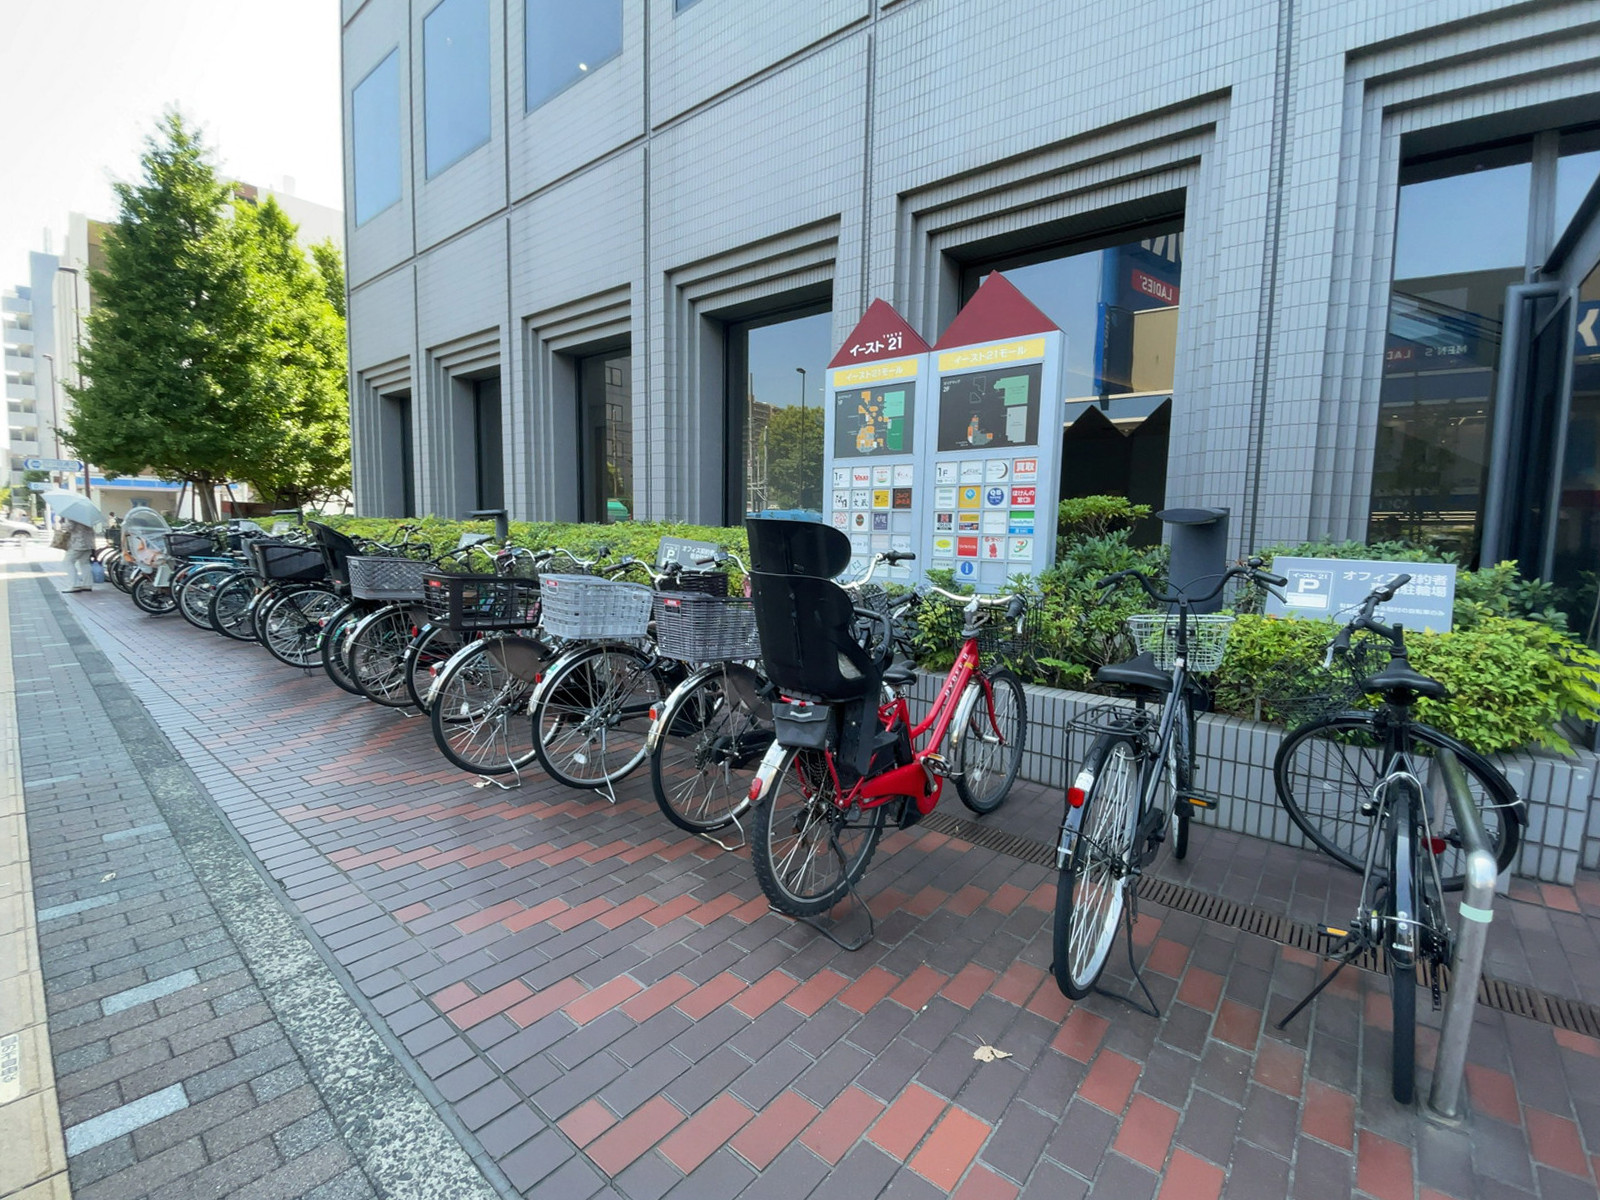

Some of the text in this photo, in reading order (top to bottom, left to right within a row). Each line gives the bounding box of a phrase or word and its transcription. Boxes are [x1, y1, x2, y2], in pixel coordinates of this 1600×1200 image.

[849, 336, 902, 357] イースト 21
[953, 346, 1026, 364] イースト21モール
[846, 366, 903, 381] イースト21モール
[667, 549, 675, 560] P
[1298, 578, 1320, 593] P
[1371, 583, 1447, 598] 駐輪場
